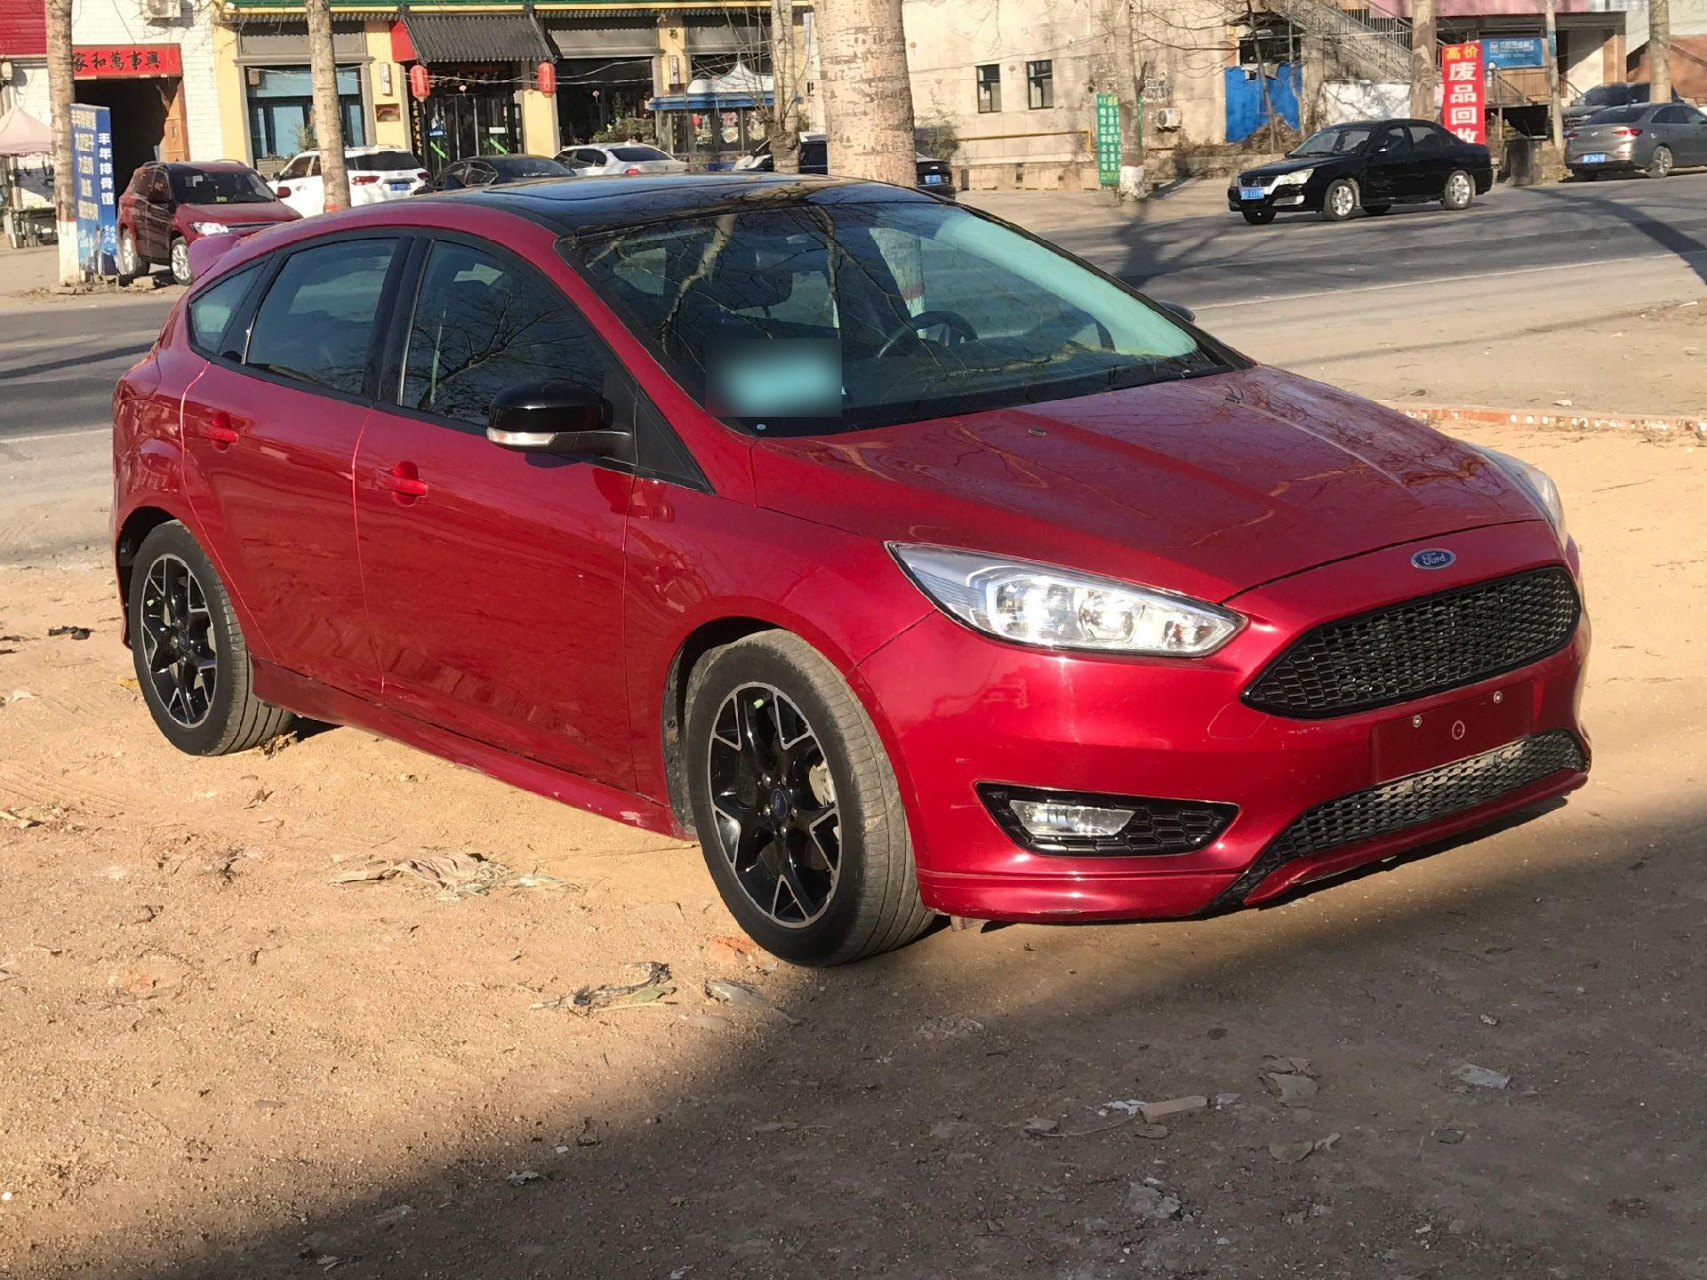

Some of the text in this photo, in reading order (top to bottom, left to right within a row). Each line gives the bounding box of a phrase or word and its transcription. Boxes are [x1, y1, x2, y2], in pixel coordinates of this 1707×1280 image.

[1445, 46, 1479, 60] 高价
[1449, 62, 1479, 143] 废品回收
[98, 133, 114, 205] 丰年排骨馆
[1421, 552, 1447, 566] Ford
